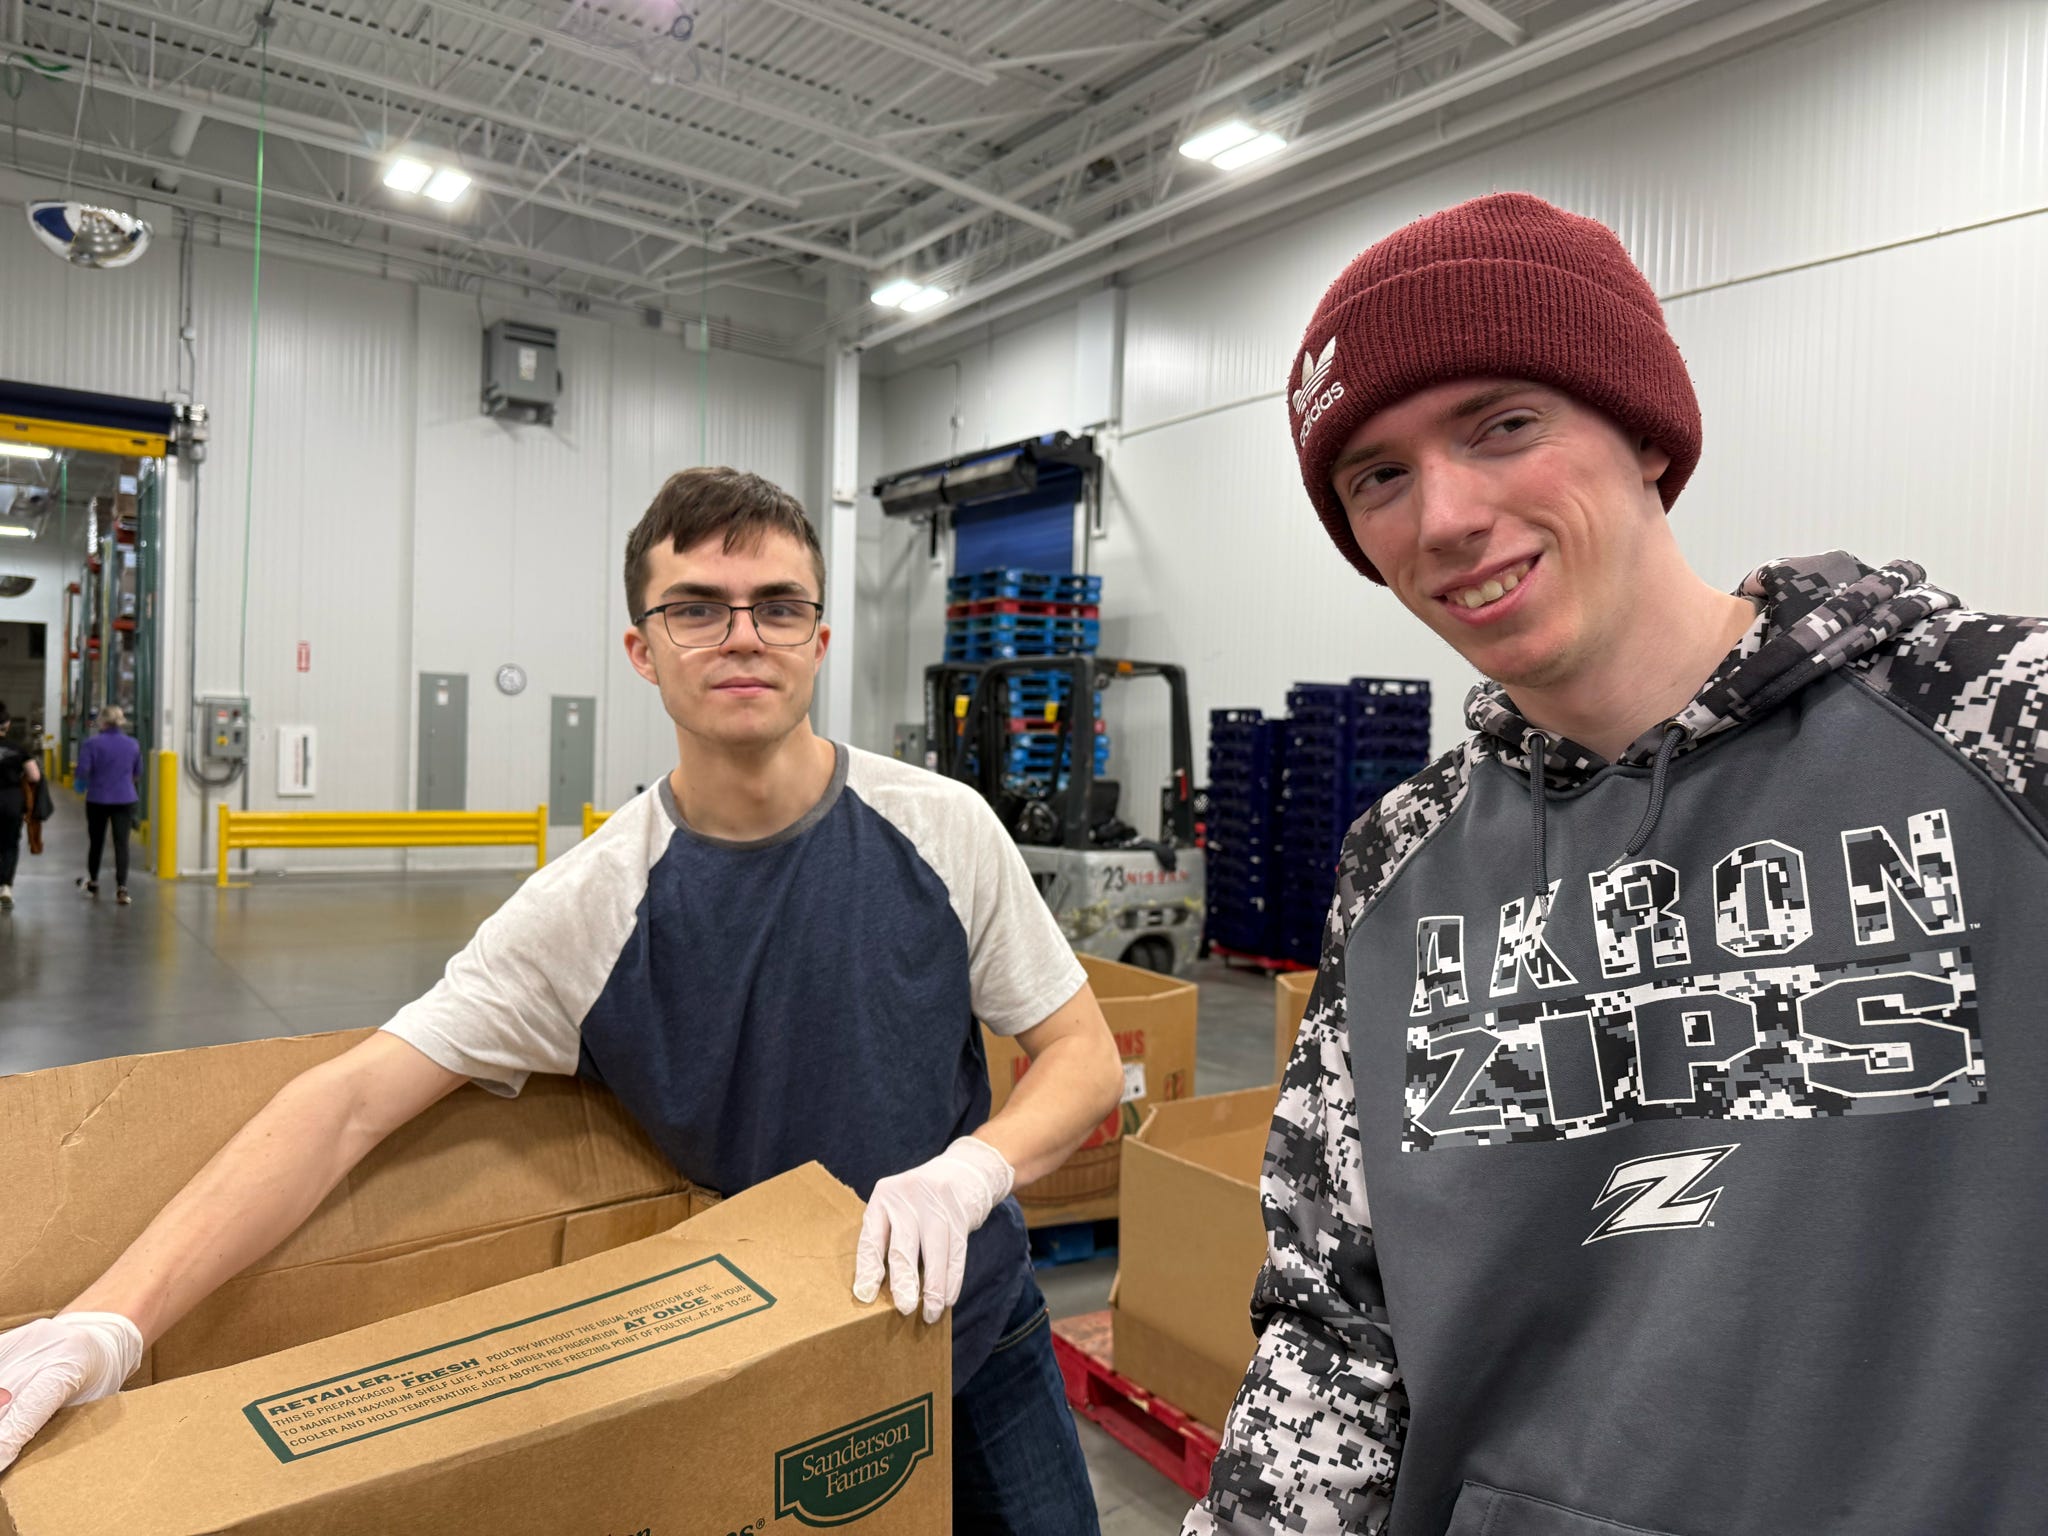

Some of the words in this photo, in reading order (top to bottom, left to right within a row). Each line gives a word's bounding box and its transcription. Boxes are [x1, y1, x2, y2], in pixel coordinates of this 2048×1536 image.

[1300, 382, 1345, 447] adidas
[1103, 865, 1125, 891] 23
[1410, 808, 1966, 1017] AKRON
[1411, 971, 1974, 1137] ZIPS
[1581, 1143, 1741, 1246] Z
[272, 1414, 301, 1428] THIS
[302, 1409, 316, 1420] IS
[316, 1385, 396, 1415] PREPACKAGED
[400, 1357, 481, 1389] FRESH
[486, 1343, 531, 1363] POULTRY
[531, 1329, 577, 1349] WITHOUT
[575, 1323, 597, 1337] THE
[595, 1313, 629, 1328] USUAL
[628, 1293, 684, 1318] PROTECTION
[682, 1288, 695, 1298] OF
[280, 1428, 299, 1438] TO
[299, 1409, 357, 1433] MAINTAIN
[358, 1392, 414, 1415] MAXIMUM
[415, 1381, 449, 1396] SHELF
[478, 1363, 511, 1378] PLACE
[510, 1352, 546, 1367] UNDER
[546, 1328, 619, 1357] REFRIGERATION
[623, 1316, 647, 1332] AT
[652, 1295, 710, 1320] ONCE
[711, 1292, 722, 1301] IN
[721, 1284, 746, 1298] YOUR
[289, 1427, 339, 1448] COOLER
[340, 1419, 366, 1433] AND
[367, 1408, 399, 1424] HOLD
[399, 1384, 480, 1414] TEMPERATURE
[481, 1375, 507, 1389] JUST
[509, 1364, 543, 1381] ABOVE
[541, 1358, 564, 1372] THE
[563, 1343, 611, 1364] FREEZING
[612, 1333, 640, 1348] POINT
[640, 1329, 653, 1339] OF
[724, 1299, 741, 1309] TO
[802, 1422, 911, 1481] Sanderson
[825, 1455, 891, 1498] Farms
